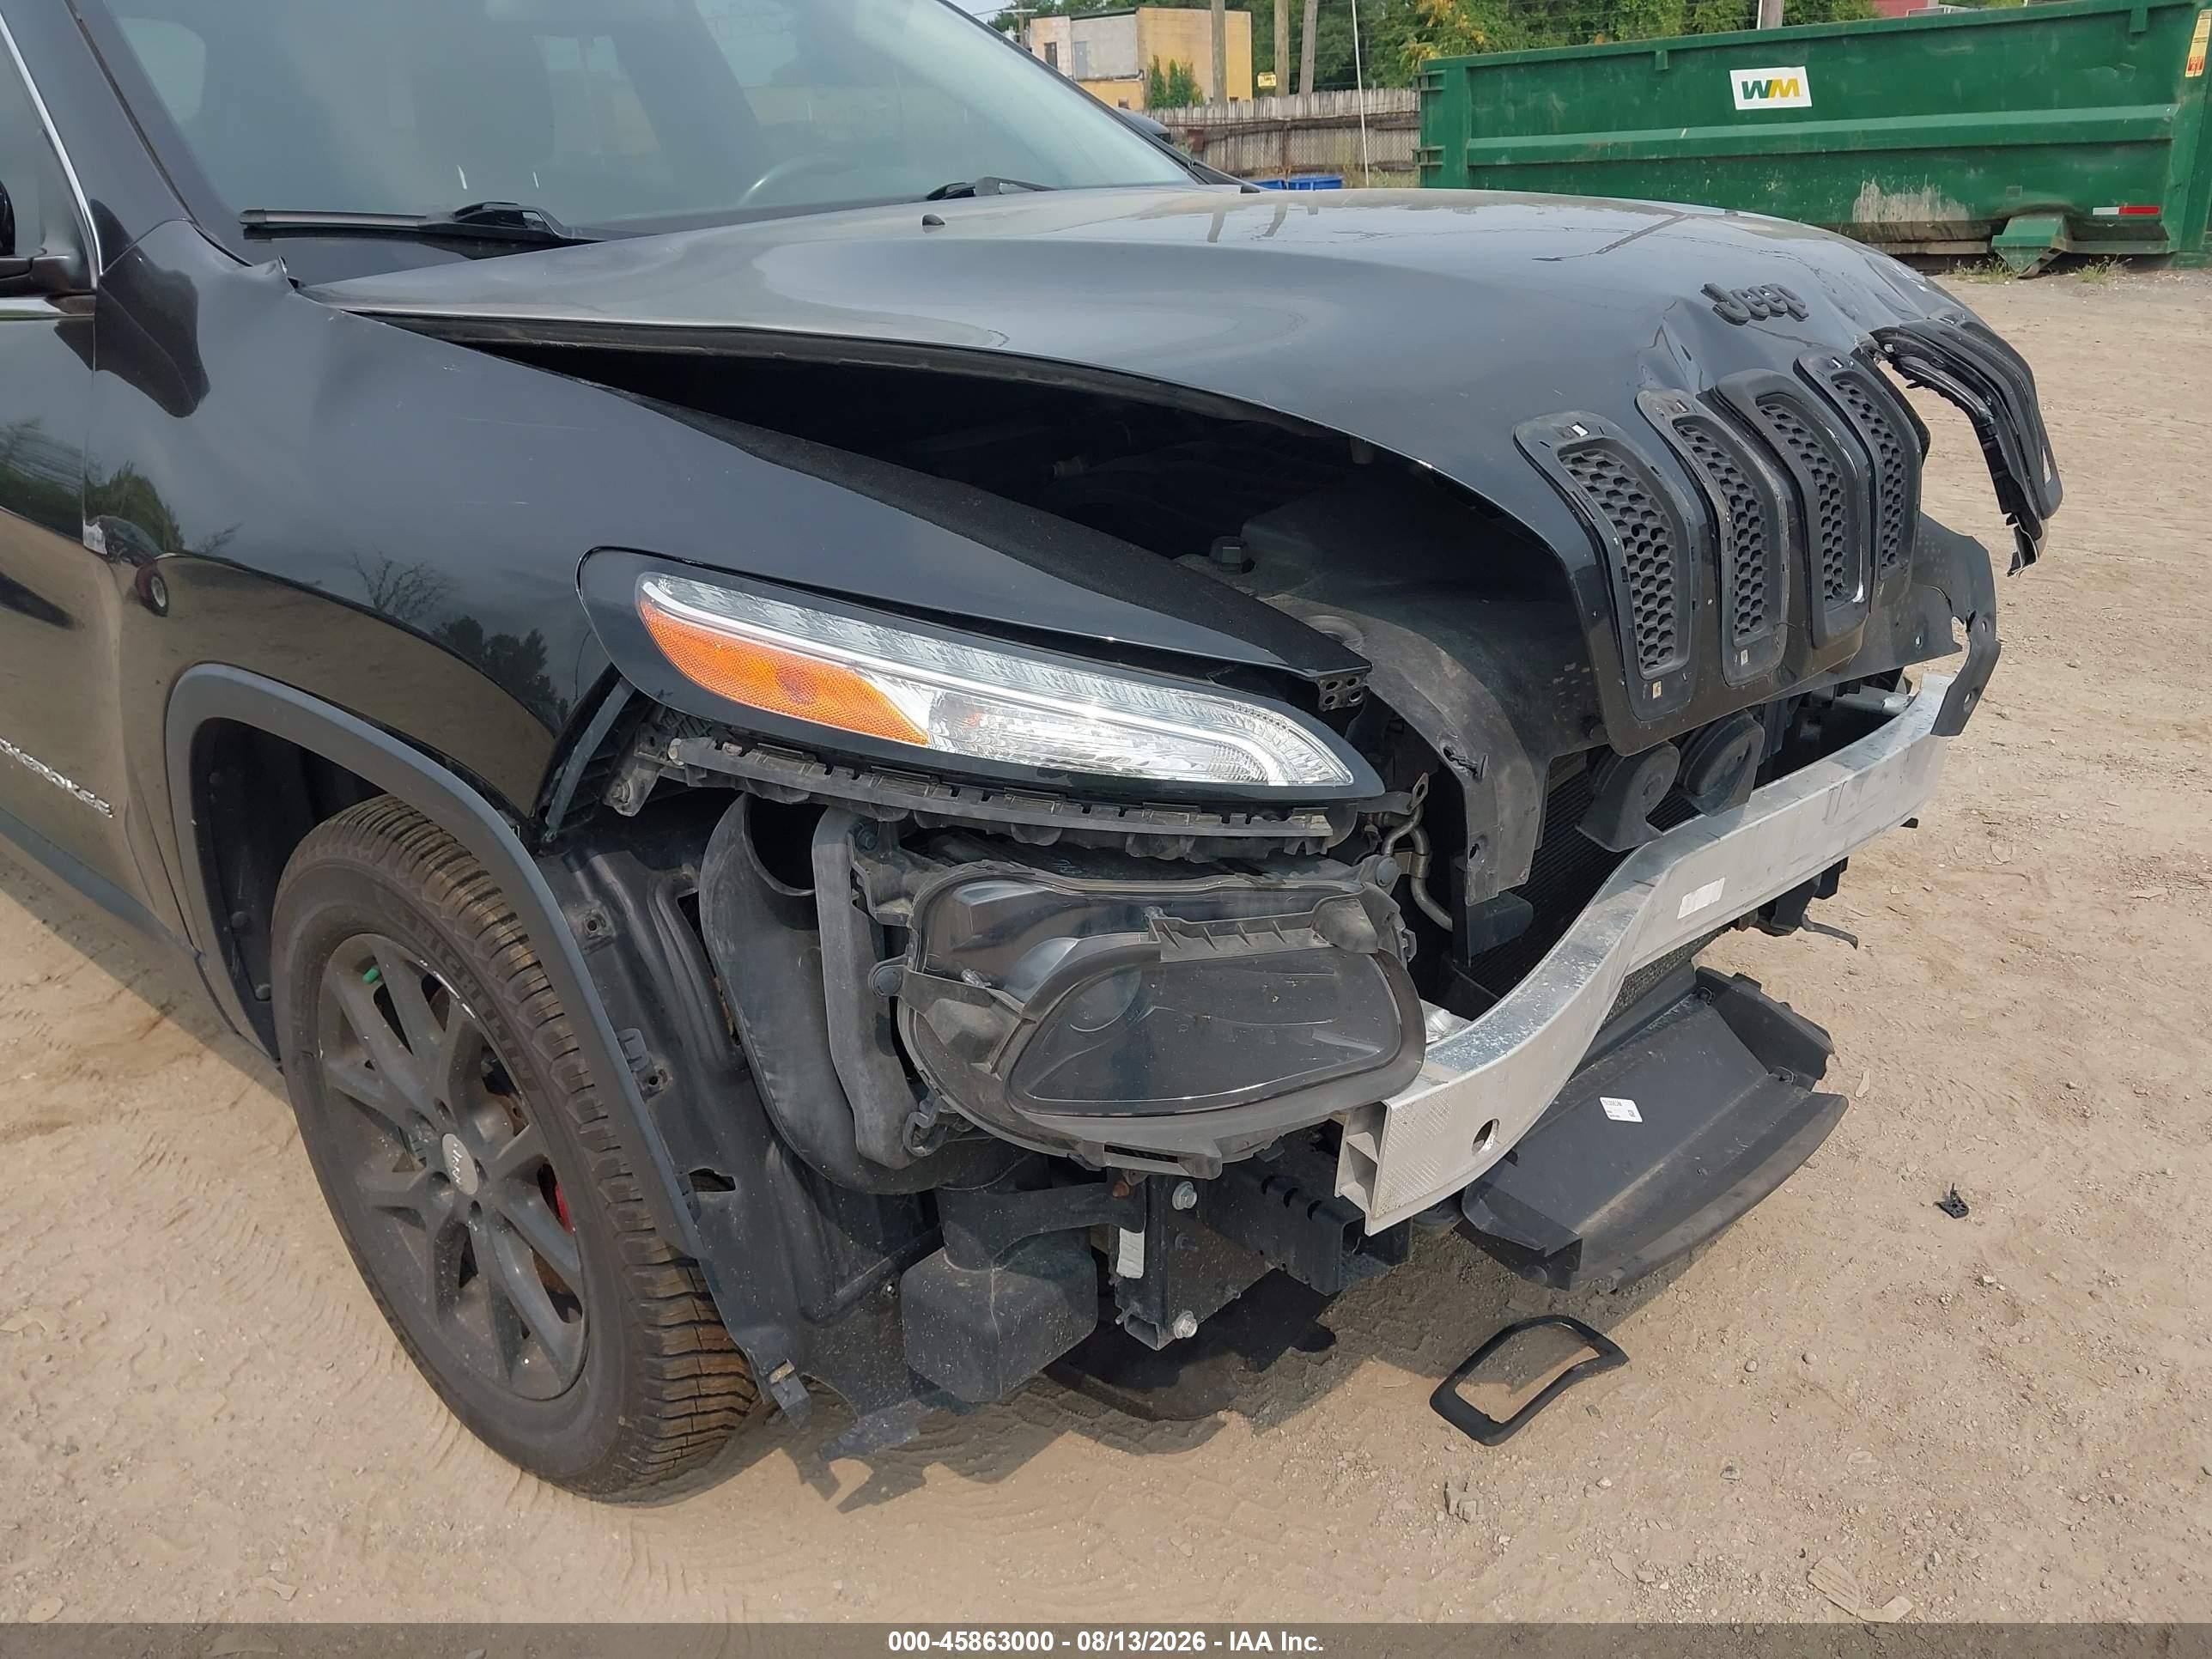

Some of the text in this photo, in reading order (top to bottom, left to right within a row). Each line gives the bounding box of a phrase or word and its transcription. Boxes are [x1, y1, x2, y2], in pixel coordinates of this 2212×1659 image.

[1741, 78, 1801, 100] WM
[1700, 283, 1809, 325] Jeep
[404, 908, 537, 1092] MICHELIN
